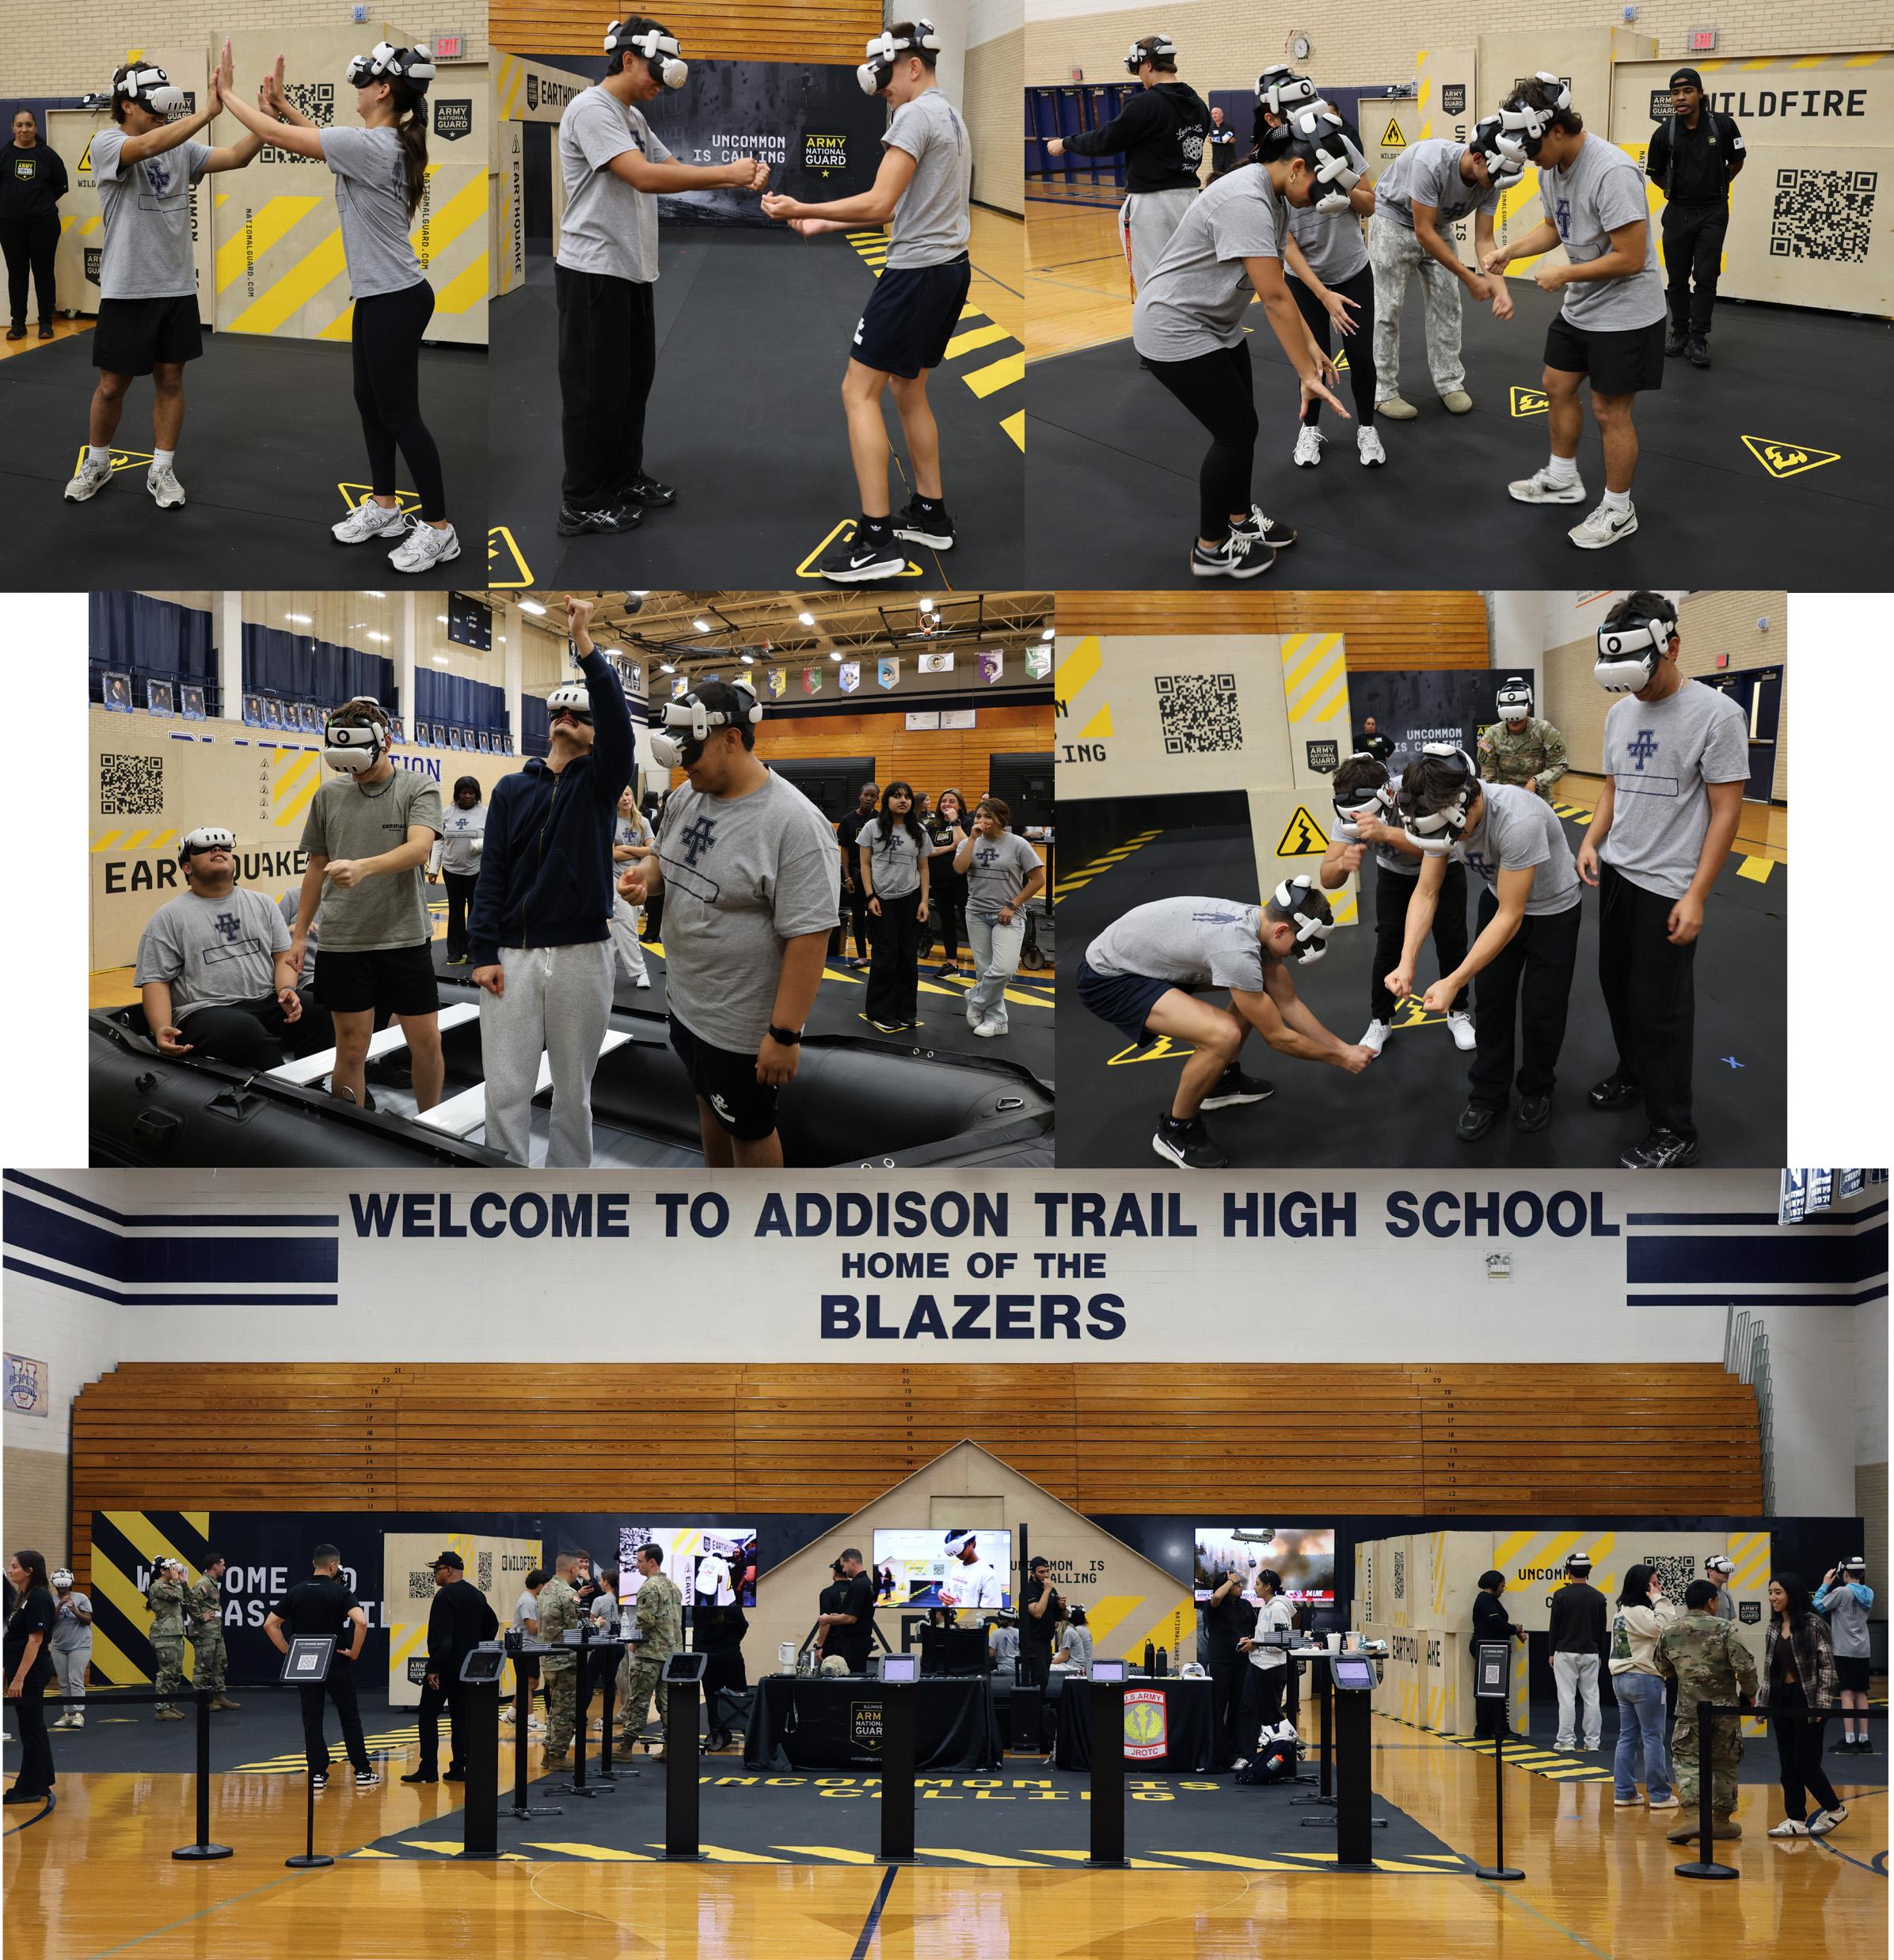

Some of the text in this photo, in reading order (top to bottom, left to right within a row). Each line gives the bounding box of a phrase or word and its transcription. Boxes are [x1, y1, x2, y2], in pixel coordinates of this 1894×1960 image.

[437, 38, 459, 55] EXIT
[1694, 32, 1713, 48] EXIT
[542, 80, 584, 107] EARTHQU
[712, 135, 785, 149] UNCOMMON
[806, 138, 846, 148] ARMY
[694, 150, 711, 161] IS
[805, 155, 846, 165] GUARD
[421, 172, 431, 270] NATIONALGUARD.COM
[513, 161, 522, 275] EARTHQUAKE
[245, 208, 254, 298] NATIONALGUARD.COM
[1406, 728, 1462, 739] UNCOMMON
[388, 754, 442, 782] TION
[348, 1190, 1620, 1239] WELCOME TO ADDISON TRAIL HIGH SCHOOL
[842, 1252, 1106, 1278] HOME OF THE
[820, 1293, 1127, 1340] BLAZERS
[509, 1555, 537, 1571] WILDFIRE
[1090, 1560, 1105, 1571] IS
[1050, 1573, 1097, 1583] ALLING
[856, 1711, 881, 1720] ARM
[855, 1726, 883, 1735] GUAR
[1131, 1747, 1158, 1757] JROTC
